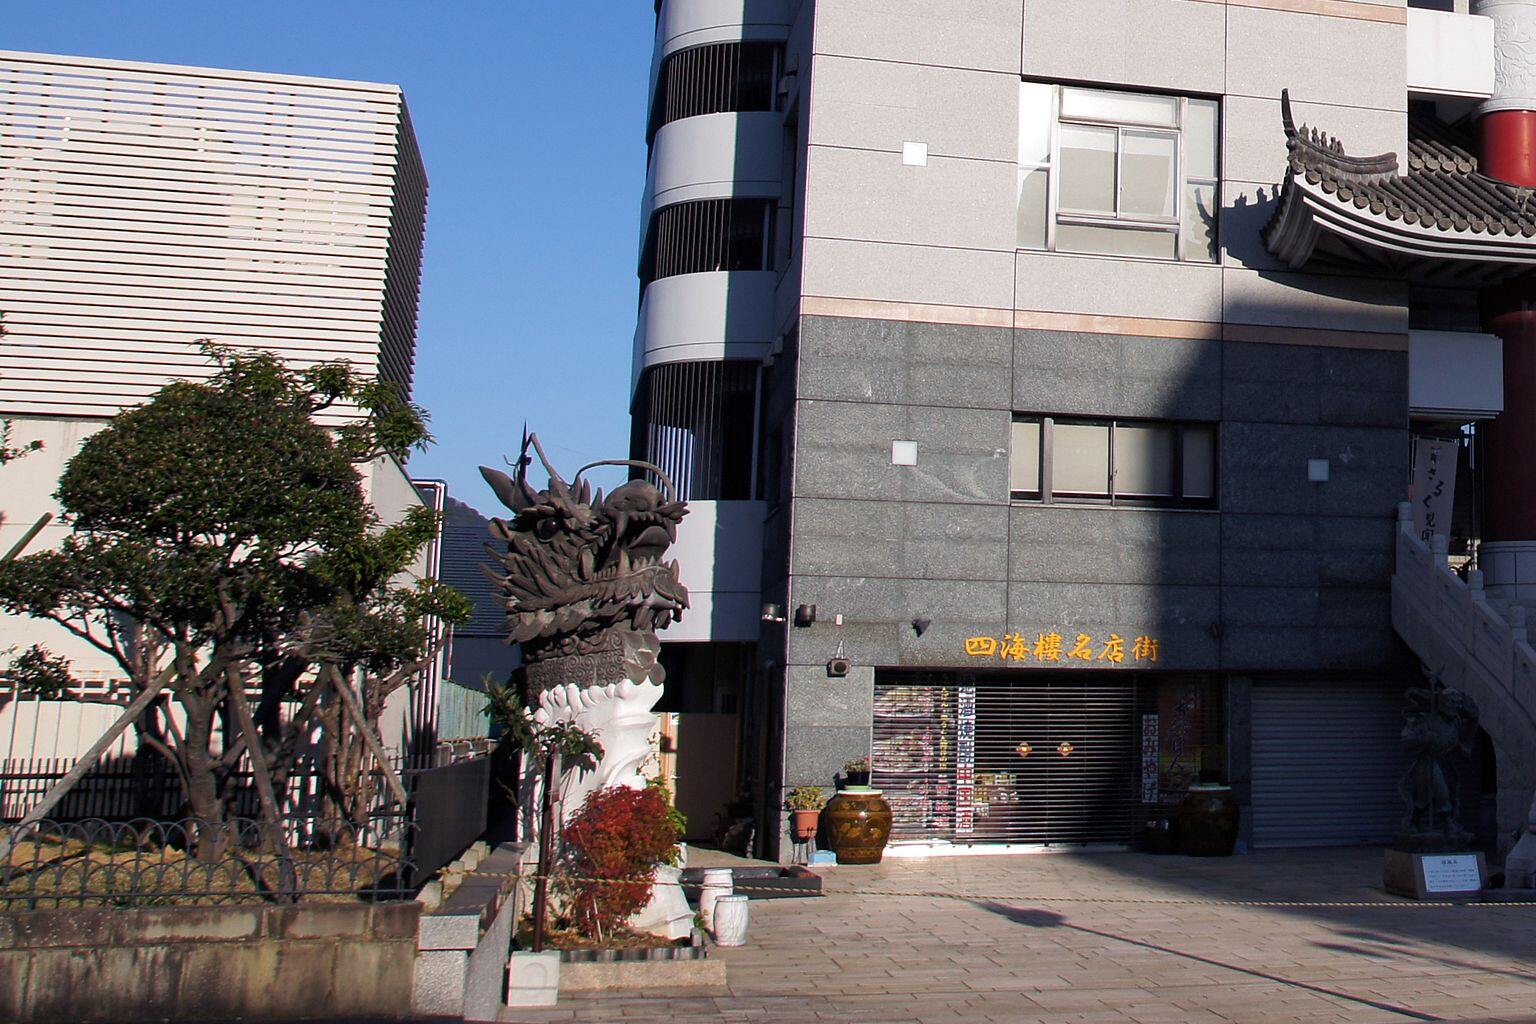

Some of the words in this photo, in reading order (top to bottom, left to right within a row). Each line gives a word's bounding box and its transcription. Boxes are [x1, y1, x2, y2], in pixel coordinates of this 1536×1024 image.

[964, 631, 1160, 664] 四海樓名店街
